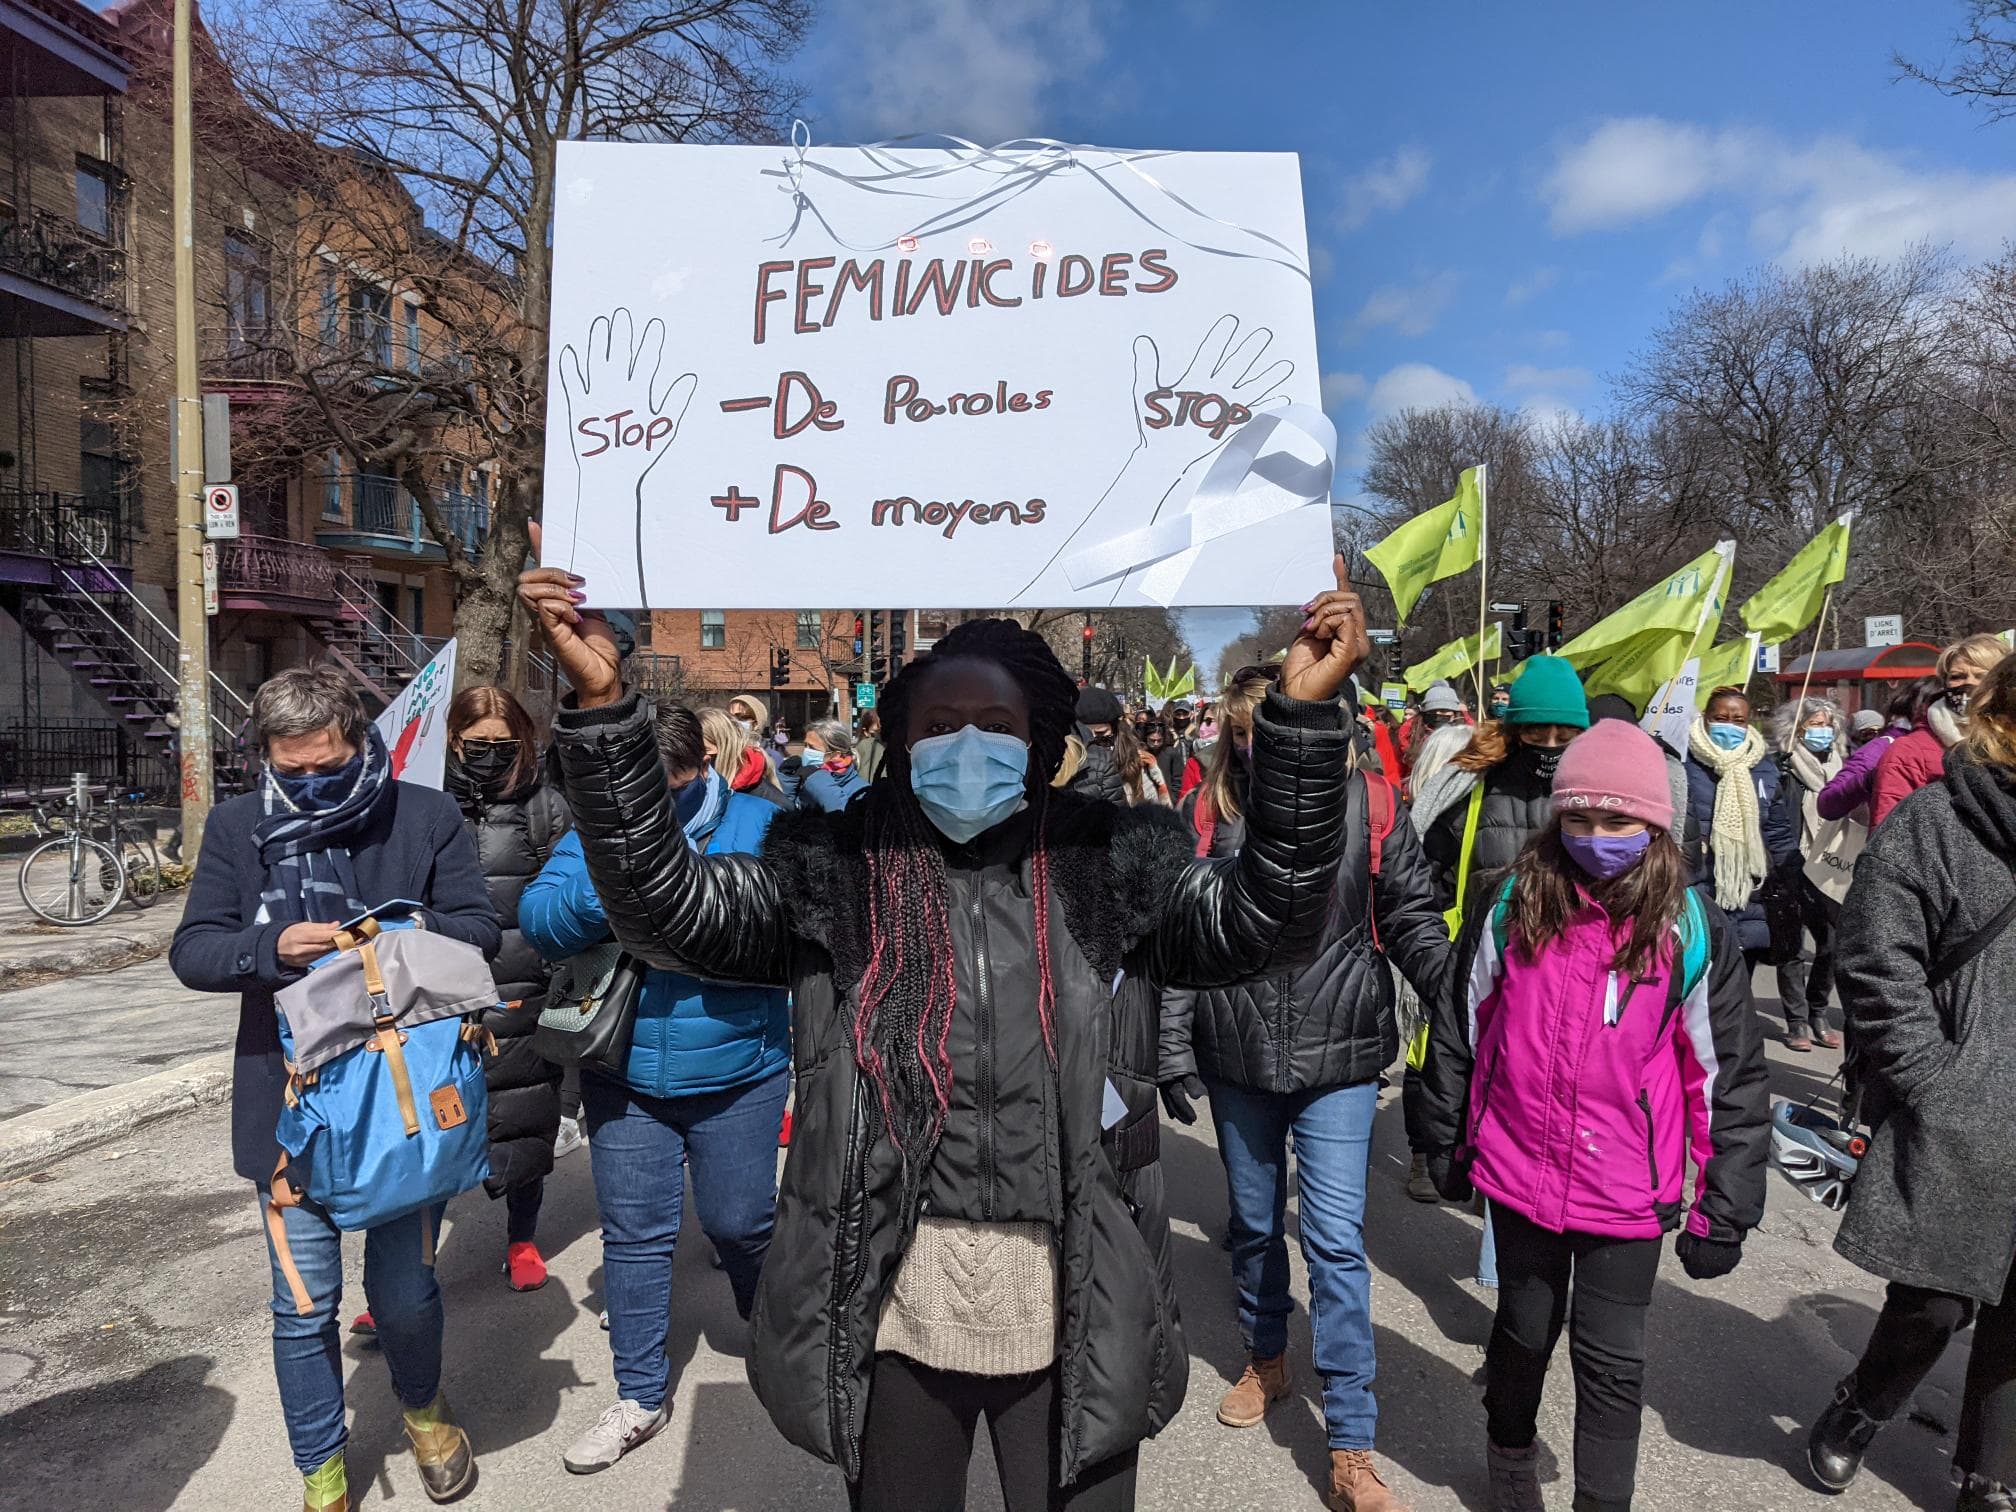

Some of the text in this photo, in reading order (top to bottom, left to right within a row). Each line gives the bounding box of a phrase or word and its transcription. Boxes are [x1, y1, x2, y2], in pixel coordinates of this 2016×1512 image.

[883, 374, 1054, 425] Paroles
[1144, 388, 1253, 441] STOP
[578, 409, 674, 458] STOP
[871, 496, 1047, 540] moyens
[1874, 620, 1894, 628] LIGNE
